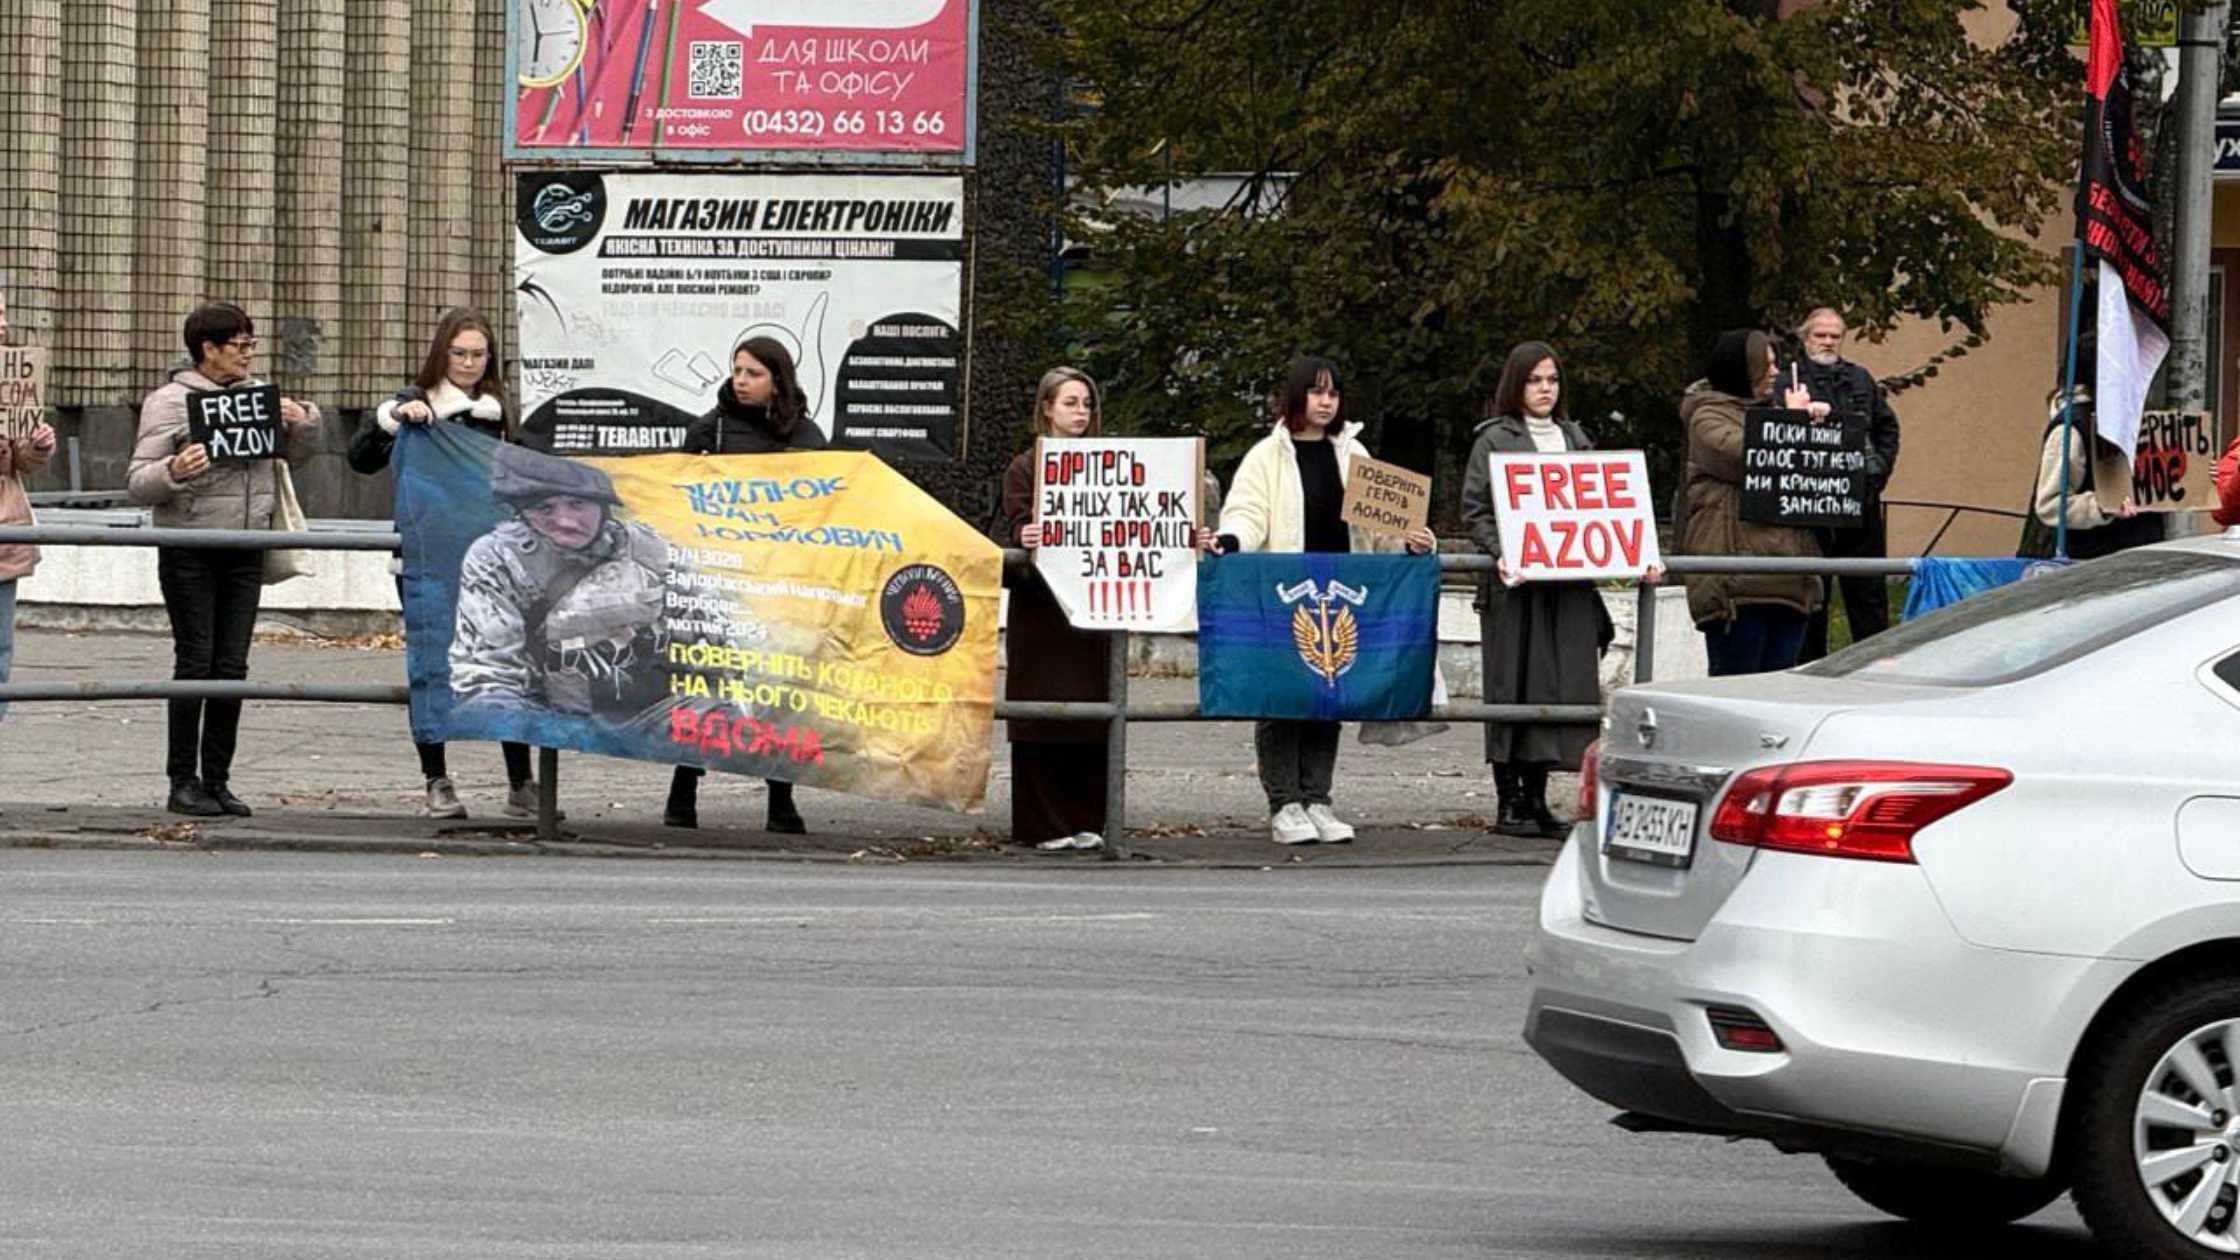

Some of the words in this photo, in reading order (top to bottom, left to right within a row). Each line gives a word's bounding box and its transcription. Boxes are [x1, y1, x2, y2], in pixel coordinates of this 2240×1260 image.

[757, 38, 817, 65] ДЛЯ
[825, 38, 929, 64] ШКОЛИ
[771, 71, 812, 95] ТА
[819, 71, 914, 101] ОФІСУ
[743, 110, 825, 136] (0432)
[833, 110, 865, 134] 66
[875, 110, 904, 134] 13
[912, 111, 945, 134] 66
[623, 198, 759, 230] МАГАЗИН
[761, 199, 954, 233] ЕЛЕКТРОНІКИ
[606, 238, 657, 256] ЯКІСНА
[659, 239, 715, 256] ТЕХНІКА
[717, 240, 736, 256] ЗА
[737, 239, 833, 258] ДОСТУПНИМИ
[835, 240, 895, 259] ЦІНАМИ!
[201, 391, 269, 427] FREE
[208, 427, 275, 458] AZOV
[1763, 421, 1806, 444] ПОКИ
[1746, 448, 1797, 470] ГОЛОС
[1801, 449, 1828, 469] ТУТ
[1504, 462, 1637, 511] FREE
[1745, 473, 1772, 491] МИ
[1779, 473, 1850, 495] КРИЧИМО
[1043, 490, 1066, 517] ЗА
[1158, 491, 1188, 518] ЯК
[1779, 493, 1841, 516] ЗАМІСТЬ
[1520, 518, 1644, 569] AZOV
[1081, 551, 1109, 577] ЗА
[1118, 551, 1163, 578] ВАС
[669, 642, 813, 680] ПОВЕРНІТЬ
[670, 673, 710, 698] НА
[718, 676, 808, 713] НЬОГО
[813, 692, 933, 735] ЧЕКАЮТЬ
[671, 706, 826, 766] ВДОМА
[1761, 730, 1790, 749] SV
